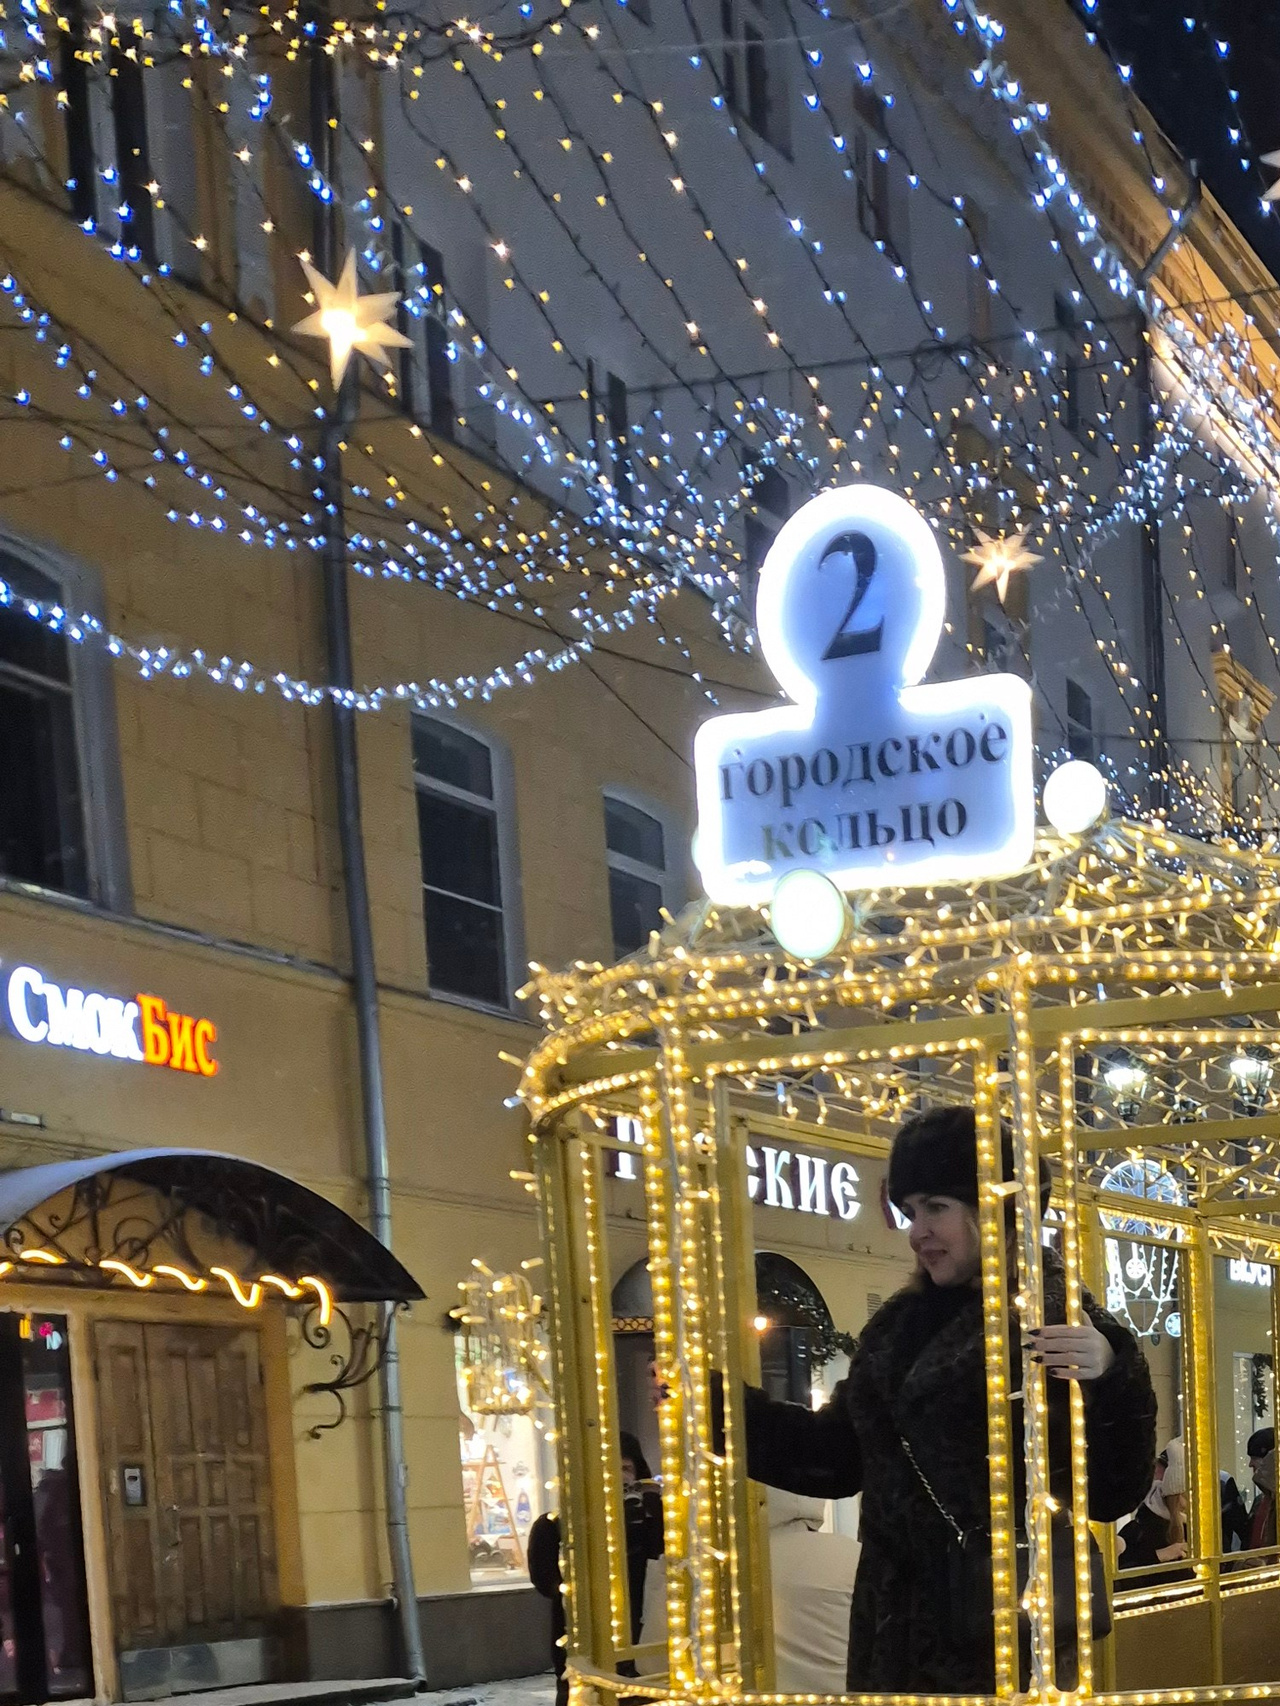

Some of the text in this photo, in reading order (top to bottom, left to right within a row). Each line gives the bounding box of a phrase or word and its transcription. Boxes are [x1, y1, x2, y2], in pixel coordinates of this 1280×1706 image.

[817, 529, 886, 661] 2
[718, 722, 1008, 808] городское
[761, 797, 968, 863] кольцо
